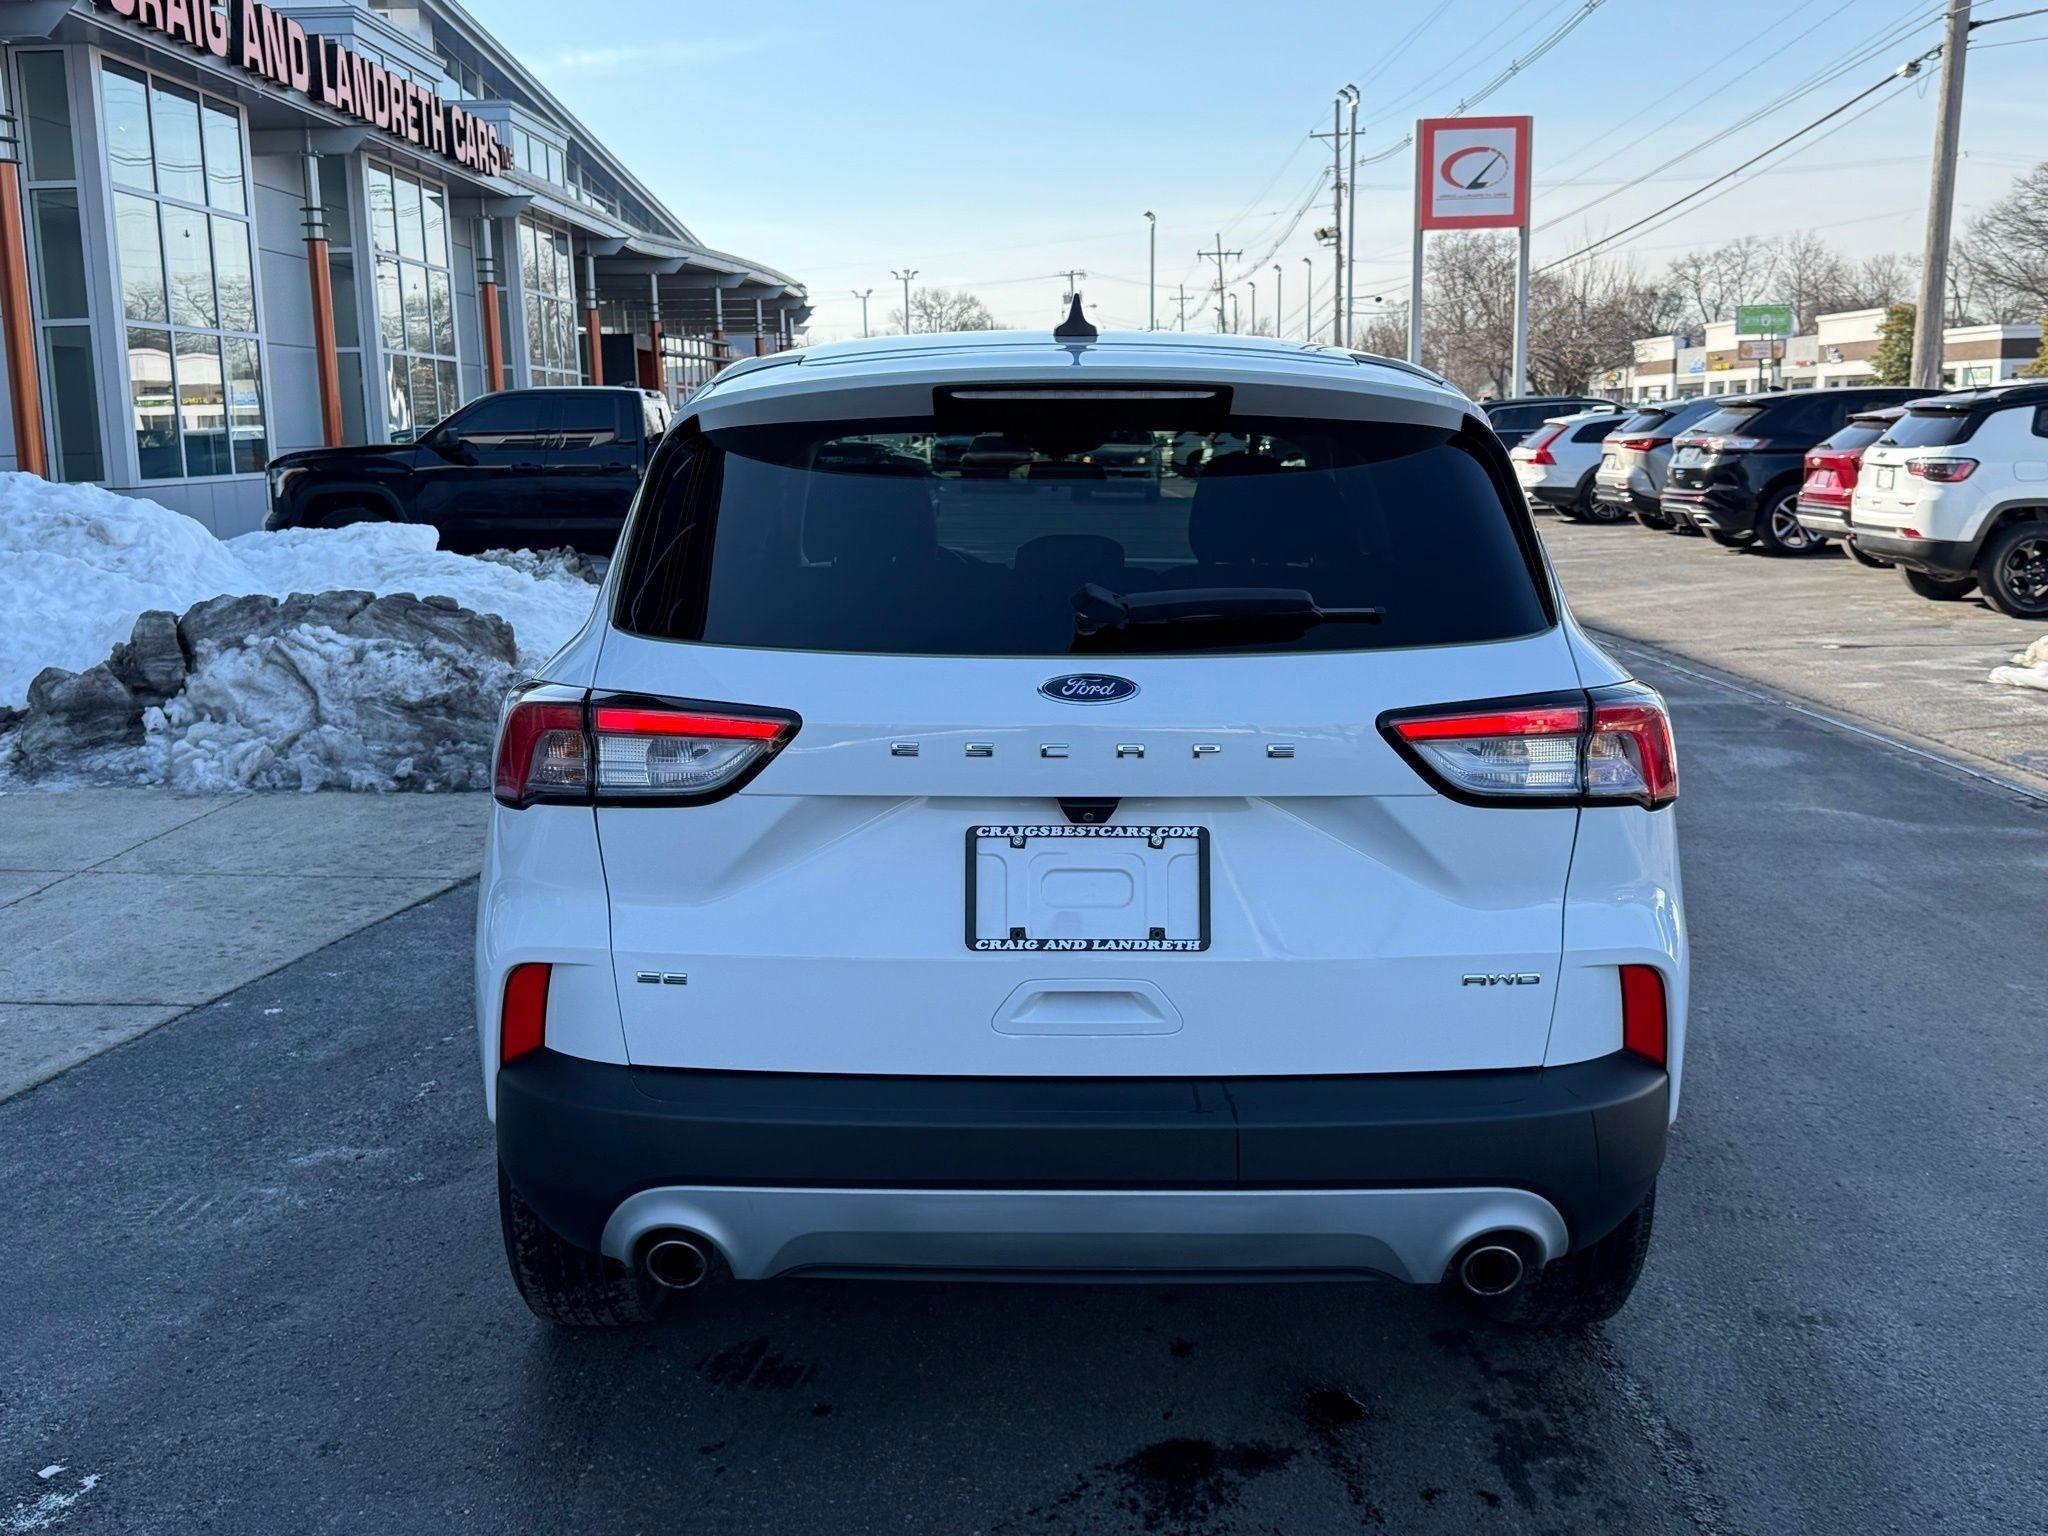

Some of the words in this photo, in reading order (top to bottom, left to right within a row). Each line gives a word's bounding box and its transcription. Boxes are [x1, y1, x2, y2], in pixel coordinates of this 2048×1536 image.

[110, 0, 228, 58] AIG
[243, 0, 309, 93] AND
[319, 33, 447, 154] LANDRETH
[451, 104, 501, 177] CARS
[1061, 677, 1116, 696] Ford
[891, 740, 1296, 760] ESCAPE
[976, 825, 1200, 838] CRAIGSBESTCARS.COM
[975, 939, 1039, 951] CRAIG
[1042, 939, 1087, 951] AND
[1092, 939, 1202, 951] LANDRETH
[636, 970, 688, 985] SE
[1462, 971, 1541, 986] AWD
